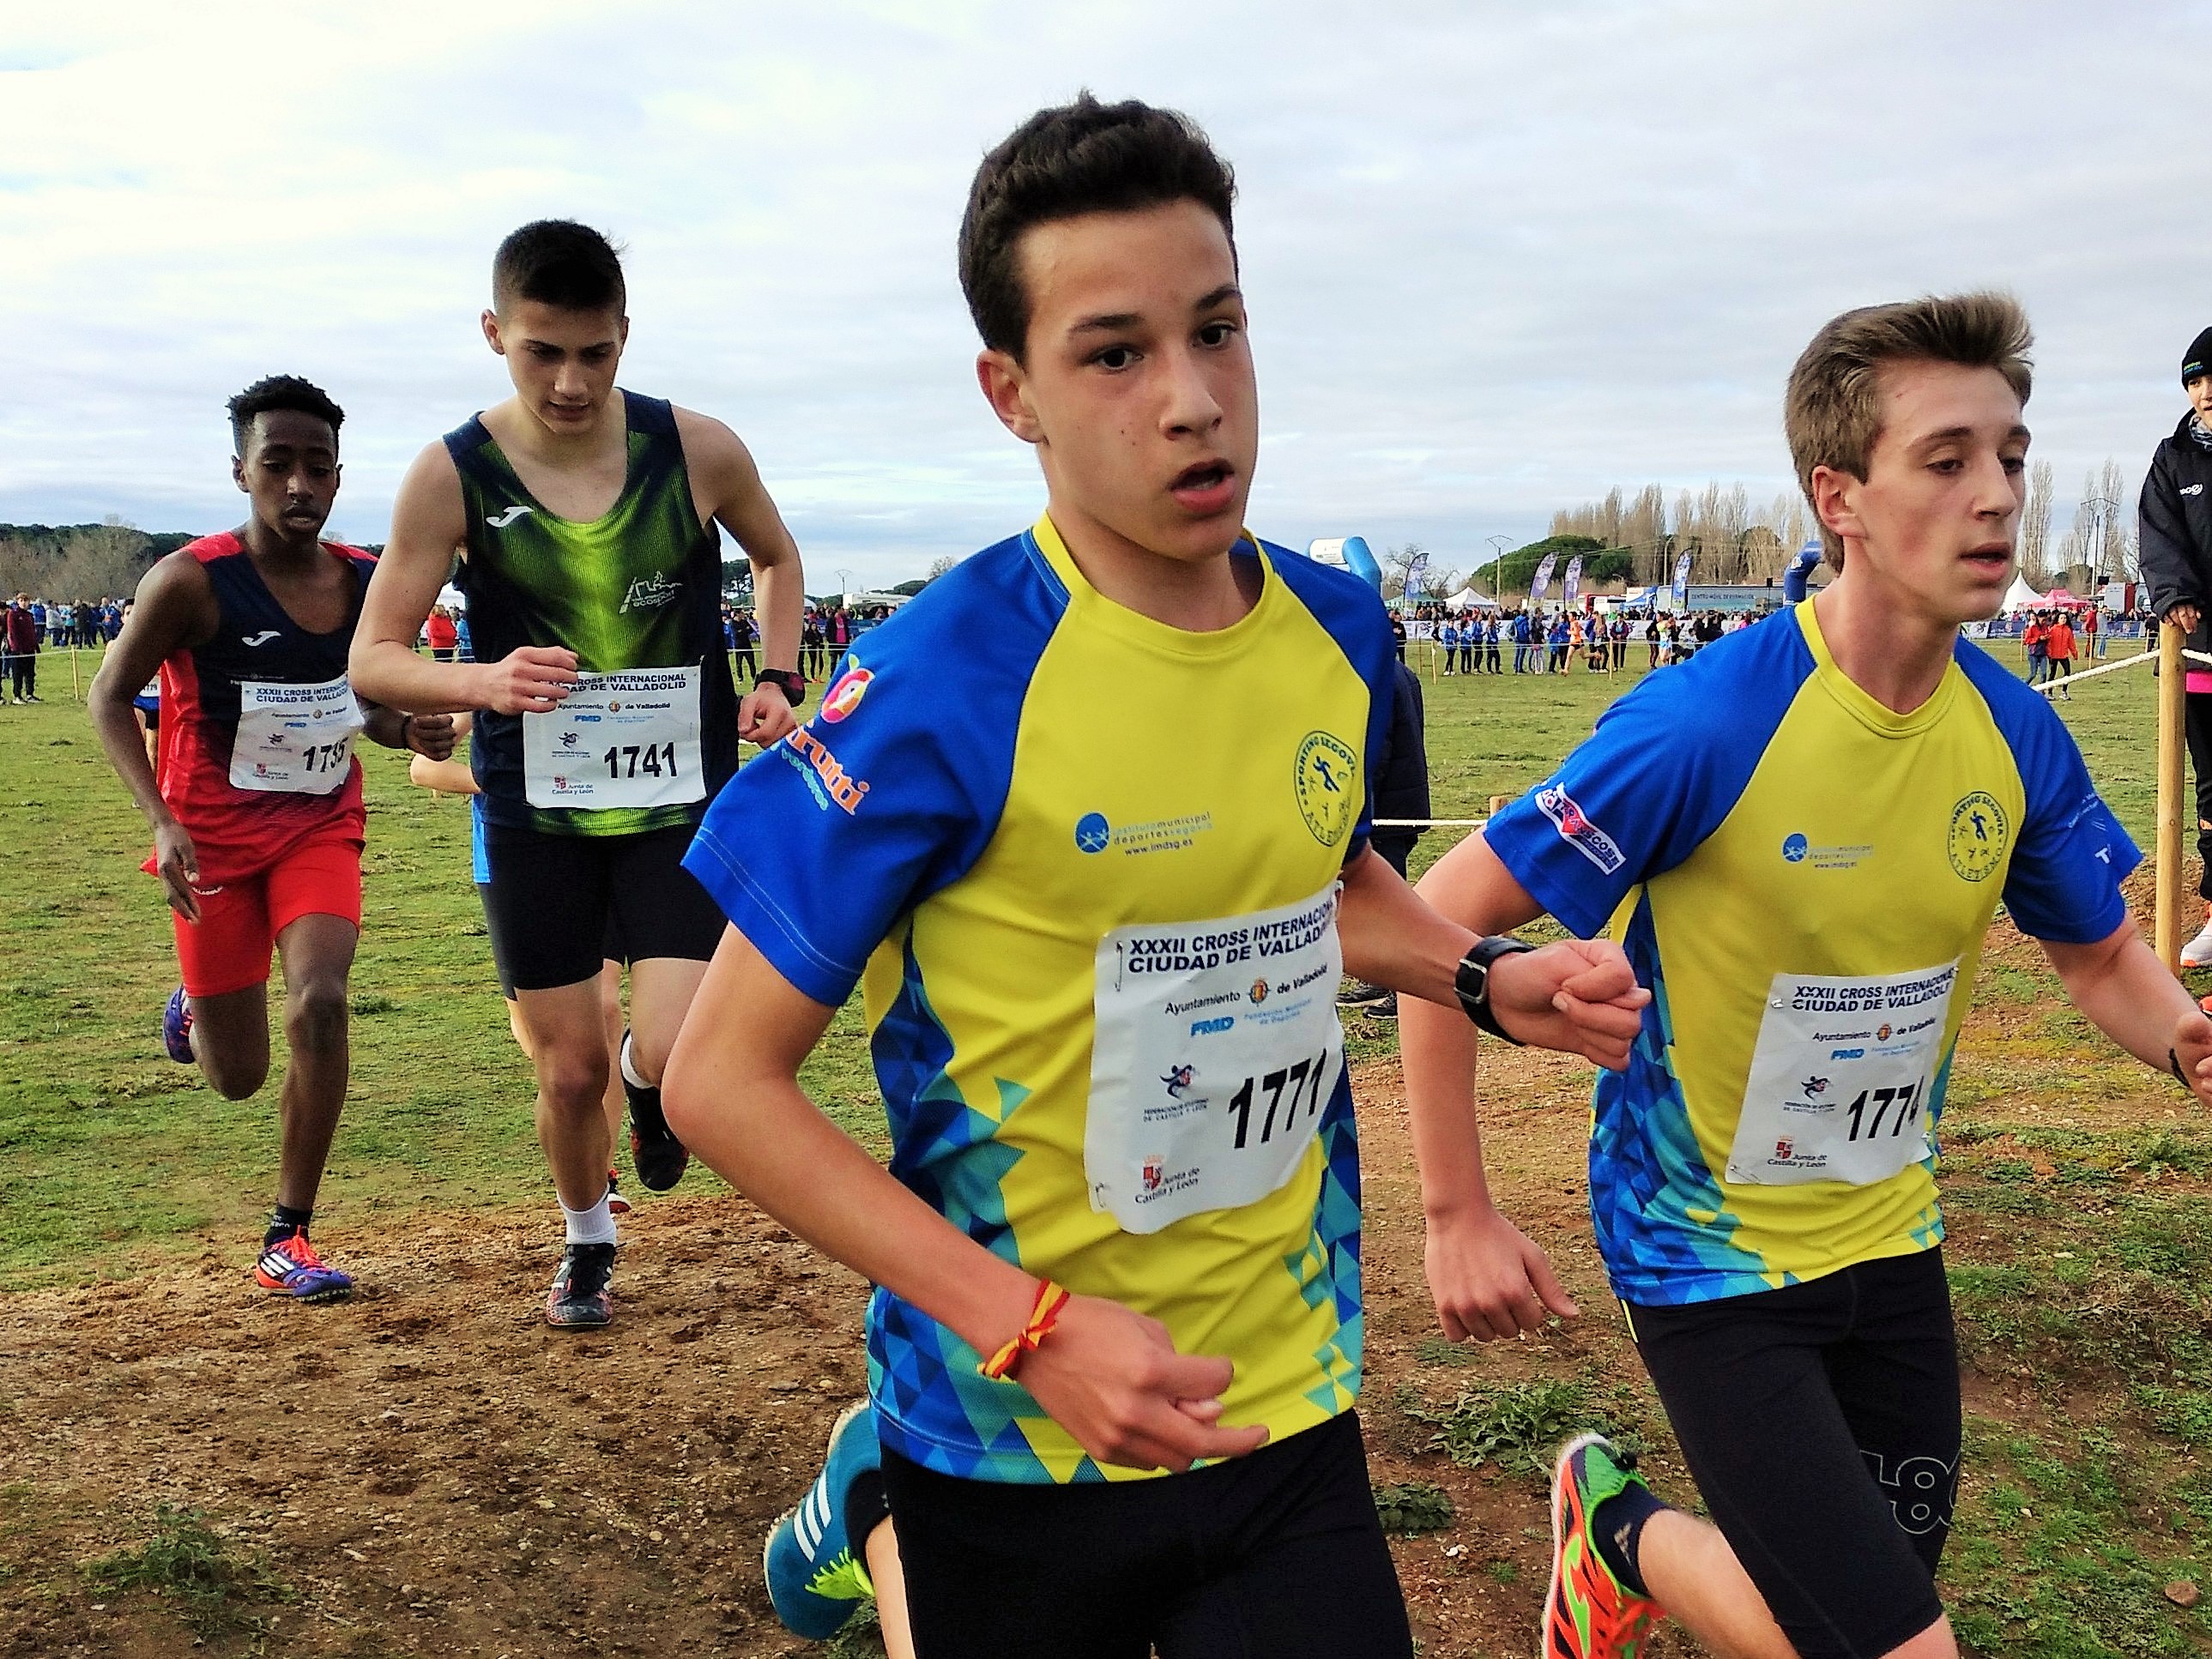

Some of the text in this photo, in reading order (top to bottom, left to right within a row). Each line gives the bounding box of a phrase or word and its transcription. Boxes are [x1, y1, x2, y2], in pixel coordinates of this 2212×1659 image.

[575, 677, 603, 686] ROSS
[606, 673, 686, 683] INTERNACIONAL
[590, 683, 607, 691] DE
[610, 681, 686, 691] VALLADOLID
[604, 742, 677, 779] 1741
[1130, 938, 1186, 955] XXXII
[1192, 927, 1249, 952] CROSS
[1128, 953, 1220, 974] CIUDAD
[1226, 944, 1252, 963] DE
[1164, 990, 1241, 1017] Ayuntamiento
[1277, 982, 1290, 994] de
[1795, 986, 1836, 999] XXXII
[1840, 986, 1883, 999] CROSS
[1792, 998, 1859, 1012] CIUDAD
[1863, 998, 1884, 1010] DE
[1190, 1016, 1235, 1037] FMD
[1812, 1031, 1871, 1042] Ayuntamiento
[1228, 1047, 1327, 1149] 1771
